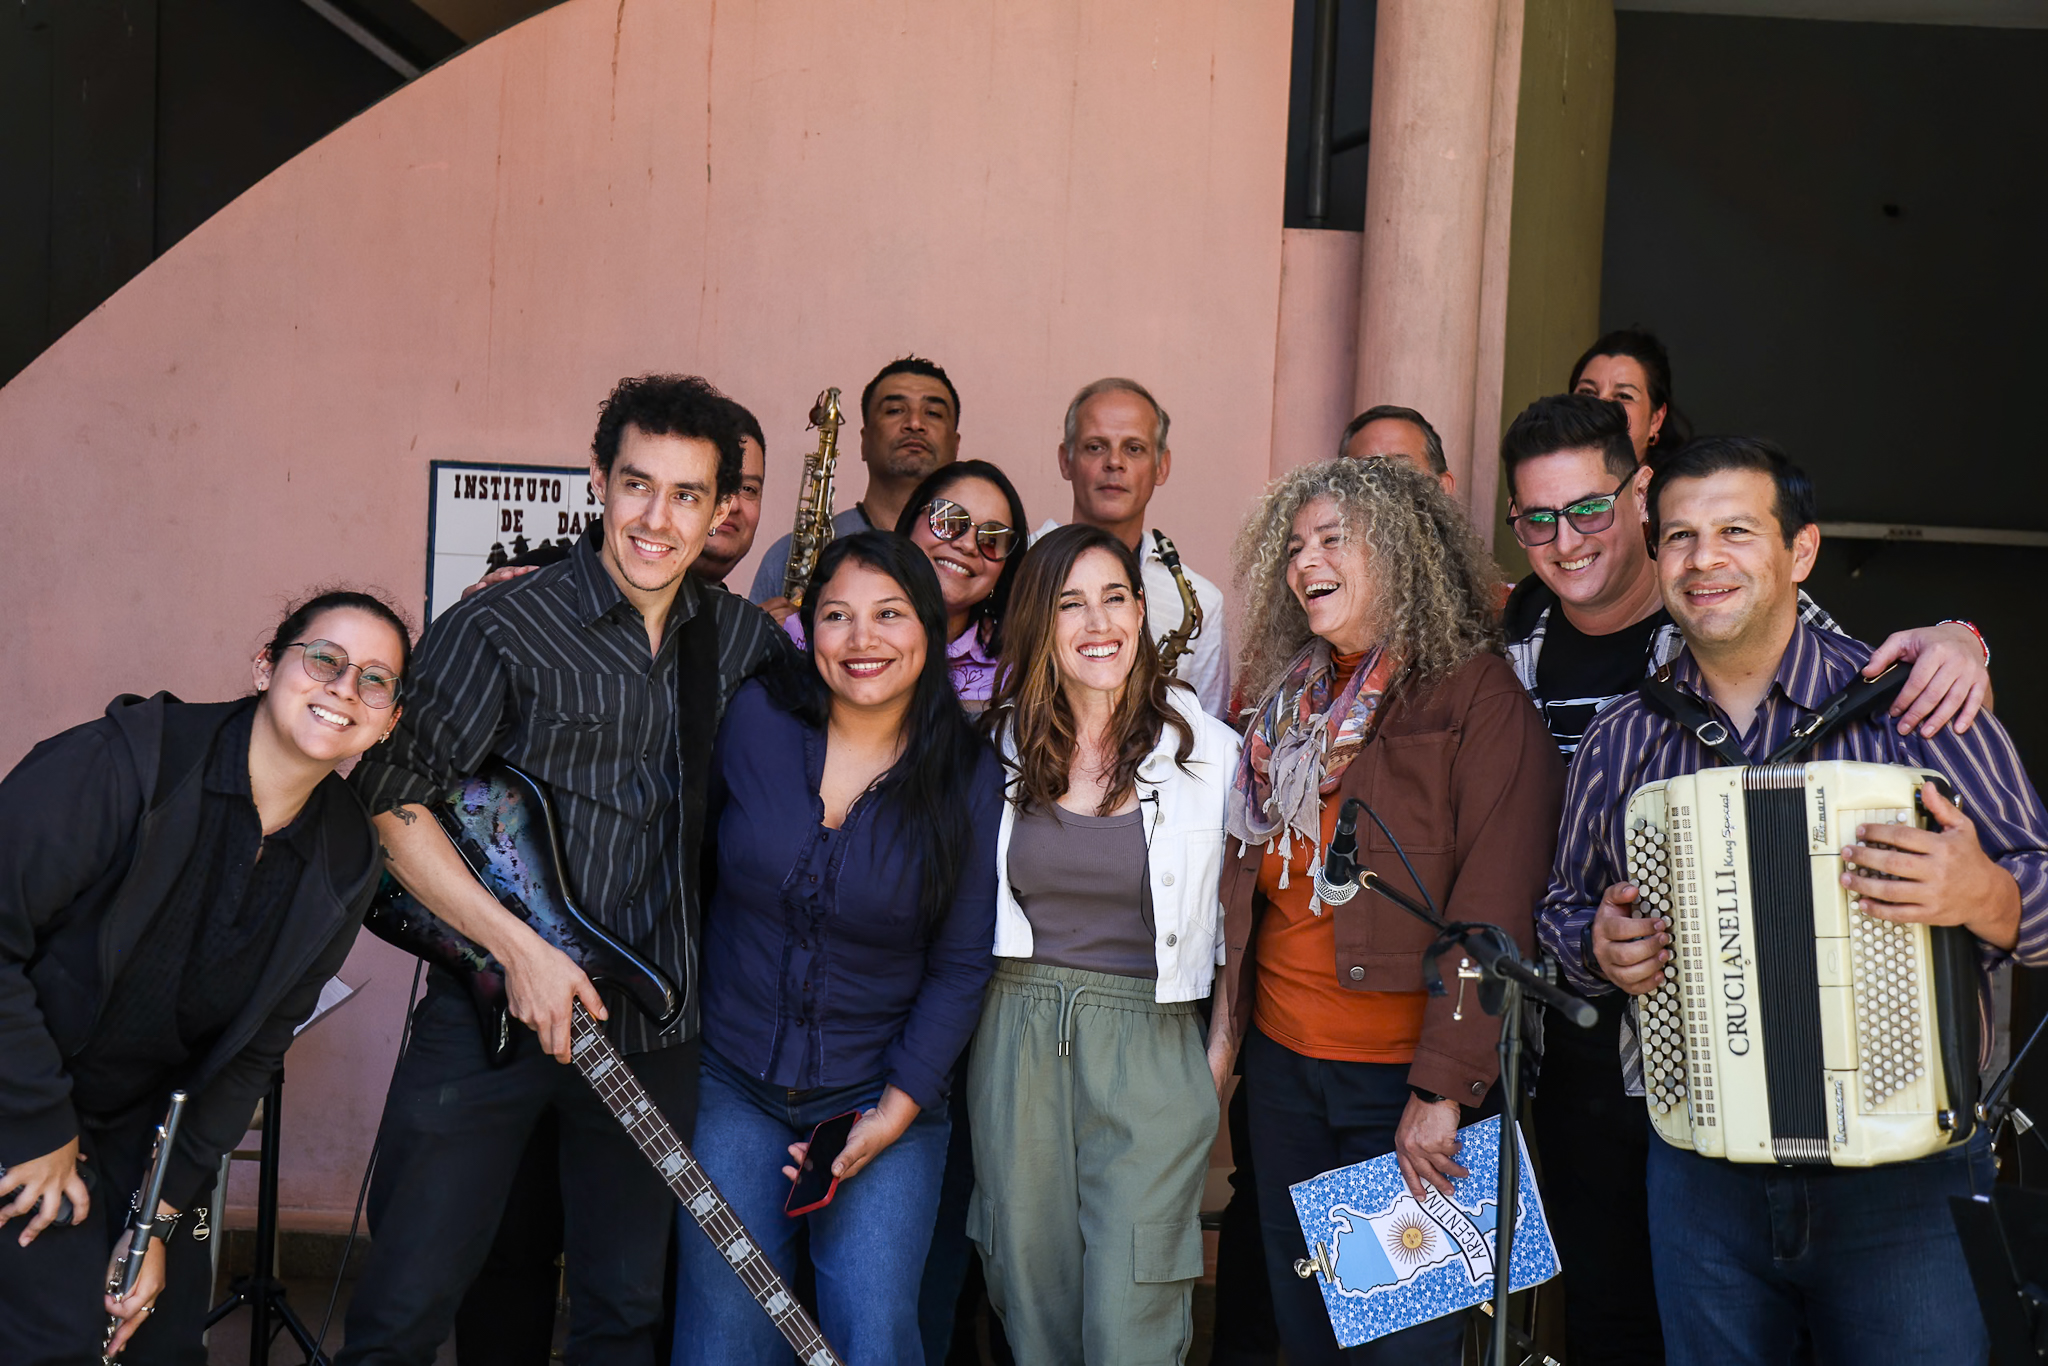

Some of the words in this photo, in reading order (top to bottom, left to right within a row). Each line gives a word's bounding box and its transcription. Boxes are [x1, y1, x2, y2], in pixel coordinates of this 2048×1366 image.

[454, 474, 561, 503] INSTITUTO
[501, 509, 523, 533] DE
[558, 511, 604, 535] DAN
[1719, 793, 1737, 838] Special
[1723, 840, 1737, 867] King
[1716, 869, 1749, 1056] CRUCIANELLI
